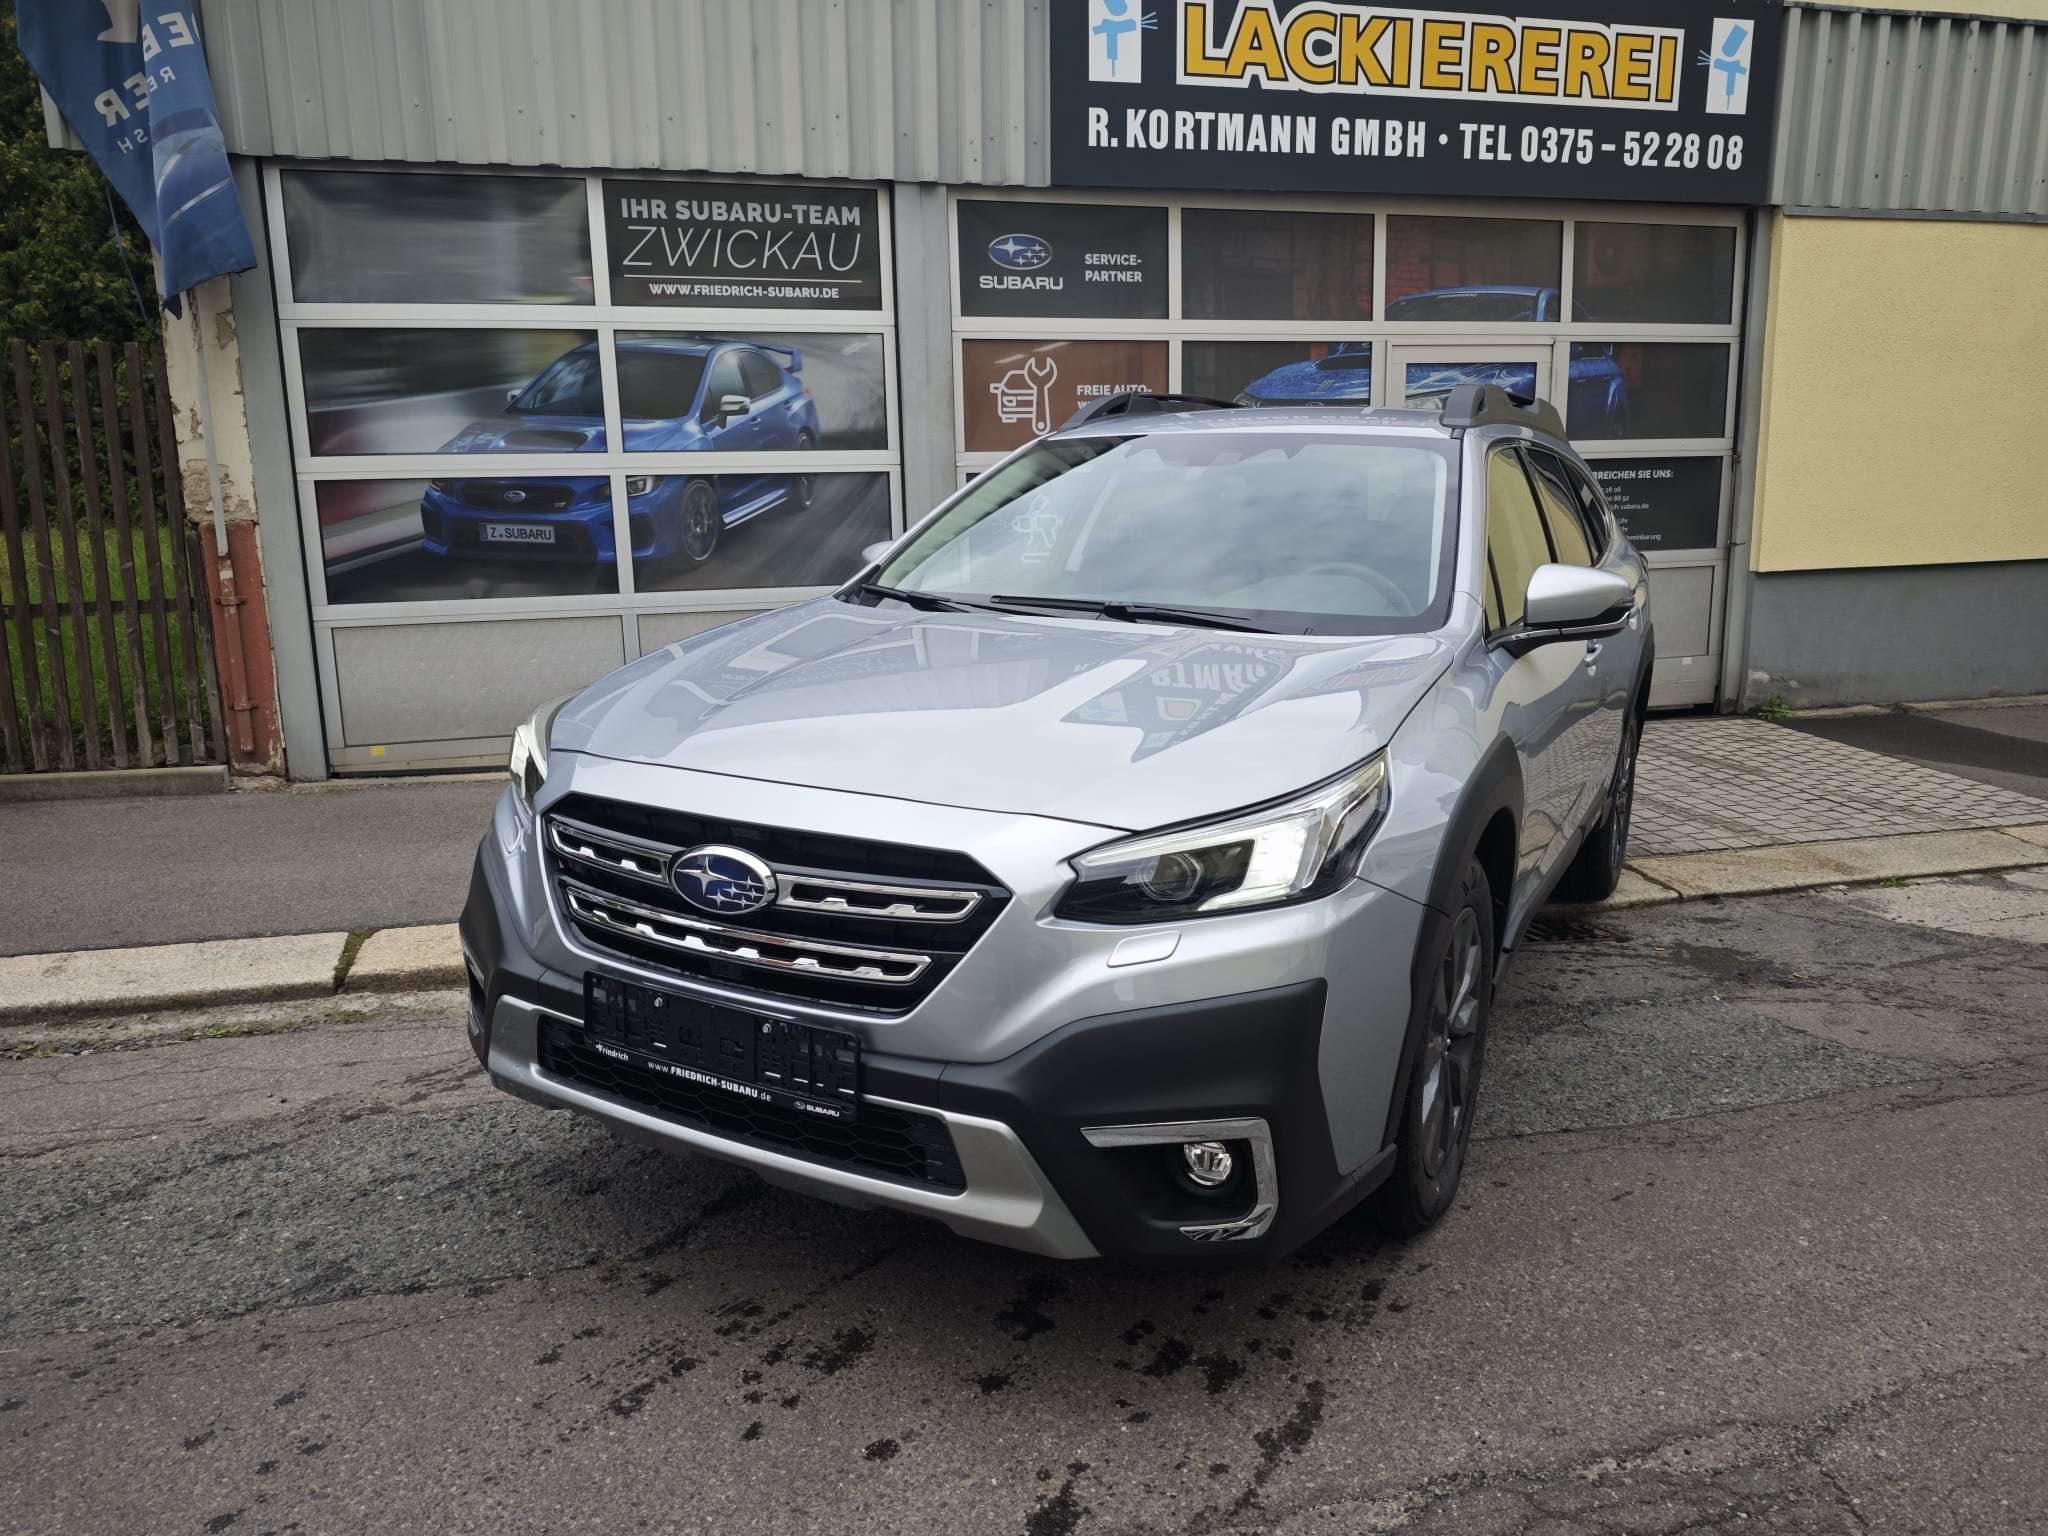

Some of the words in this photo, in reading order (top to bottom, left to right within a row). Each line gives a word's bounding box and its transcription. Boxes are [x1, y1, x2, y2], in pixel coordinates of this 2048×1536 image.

[1183, 2, 1679, 103] LACKIEREREI
[1088, 107, 1119, 148] R.
[1126, 108, 1316, 154] KORTMANN
[1331, 116, 1426, 158] GMBH
[1459, 123, 1512, 161] TEL
[621, 198, 668, 220] IHR
[675, 200, 861, 226] SUBARU-TEAM
[622, 225, 861, 271] ZWICKAU
[1084, 253, 1142, 266] SERVICE-
[979, 275, 1064, 290] SUBARU
[1084, 270, 1143, 283] PARTNER
[648, 283, 840, 299] WWW.FRIEDRICH-SUBARU.DE
[1076, 384, 1111, 396] FREIE
[1637, 470, 1652, 479] SIE
[806, 1104, 840, 1117] SUBARU
